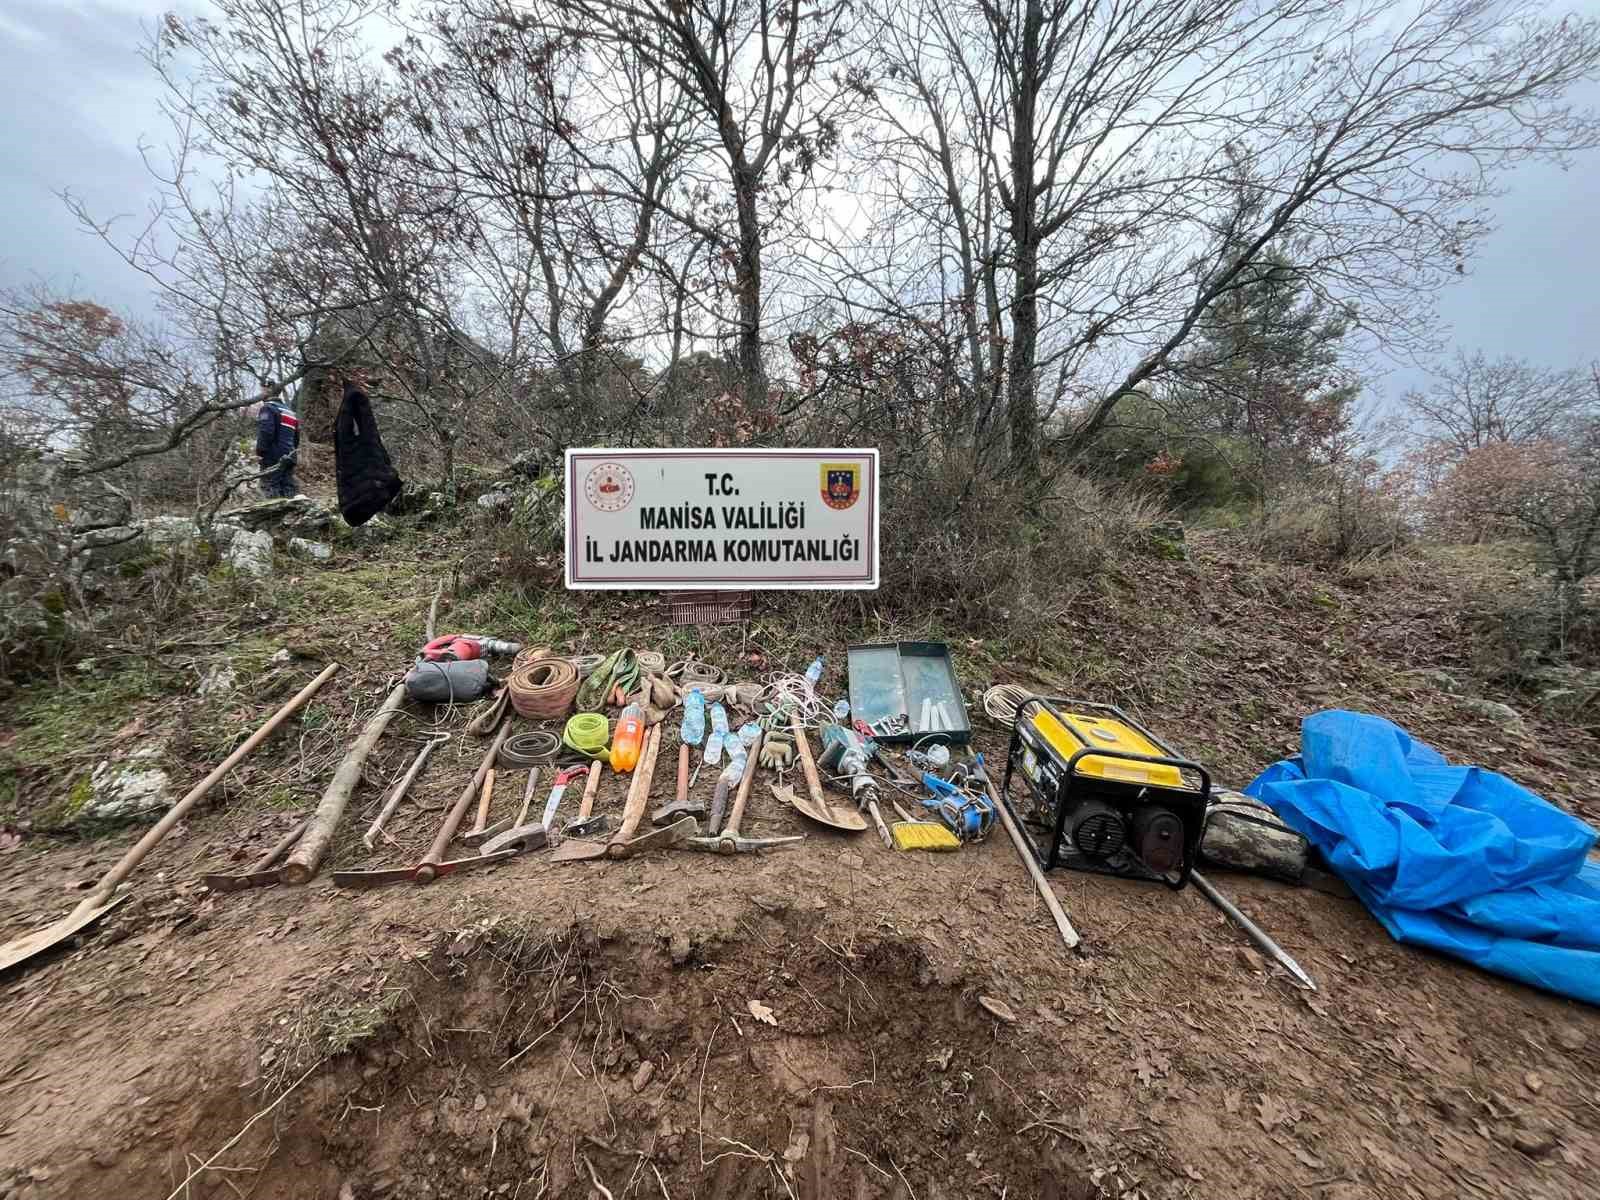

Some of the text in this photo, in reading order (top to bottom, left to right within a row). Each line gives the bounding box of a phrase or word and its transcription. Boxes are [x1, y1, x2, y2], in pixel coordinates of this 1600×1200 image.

[705, 473, 739, 496] T.C.
[640, 501, 804, 529] MANİSA VALİLİĞİ
[586, 534, 859, 562] İL JANDARMA KOMUTANLIĞI
